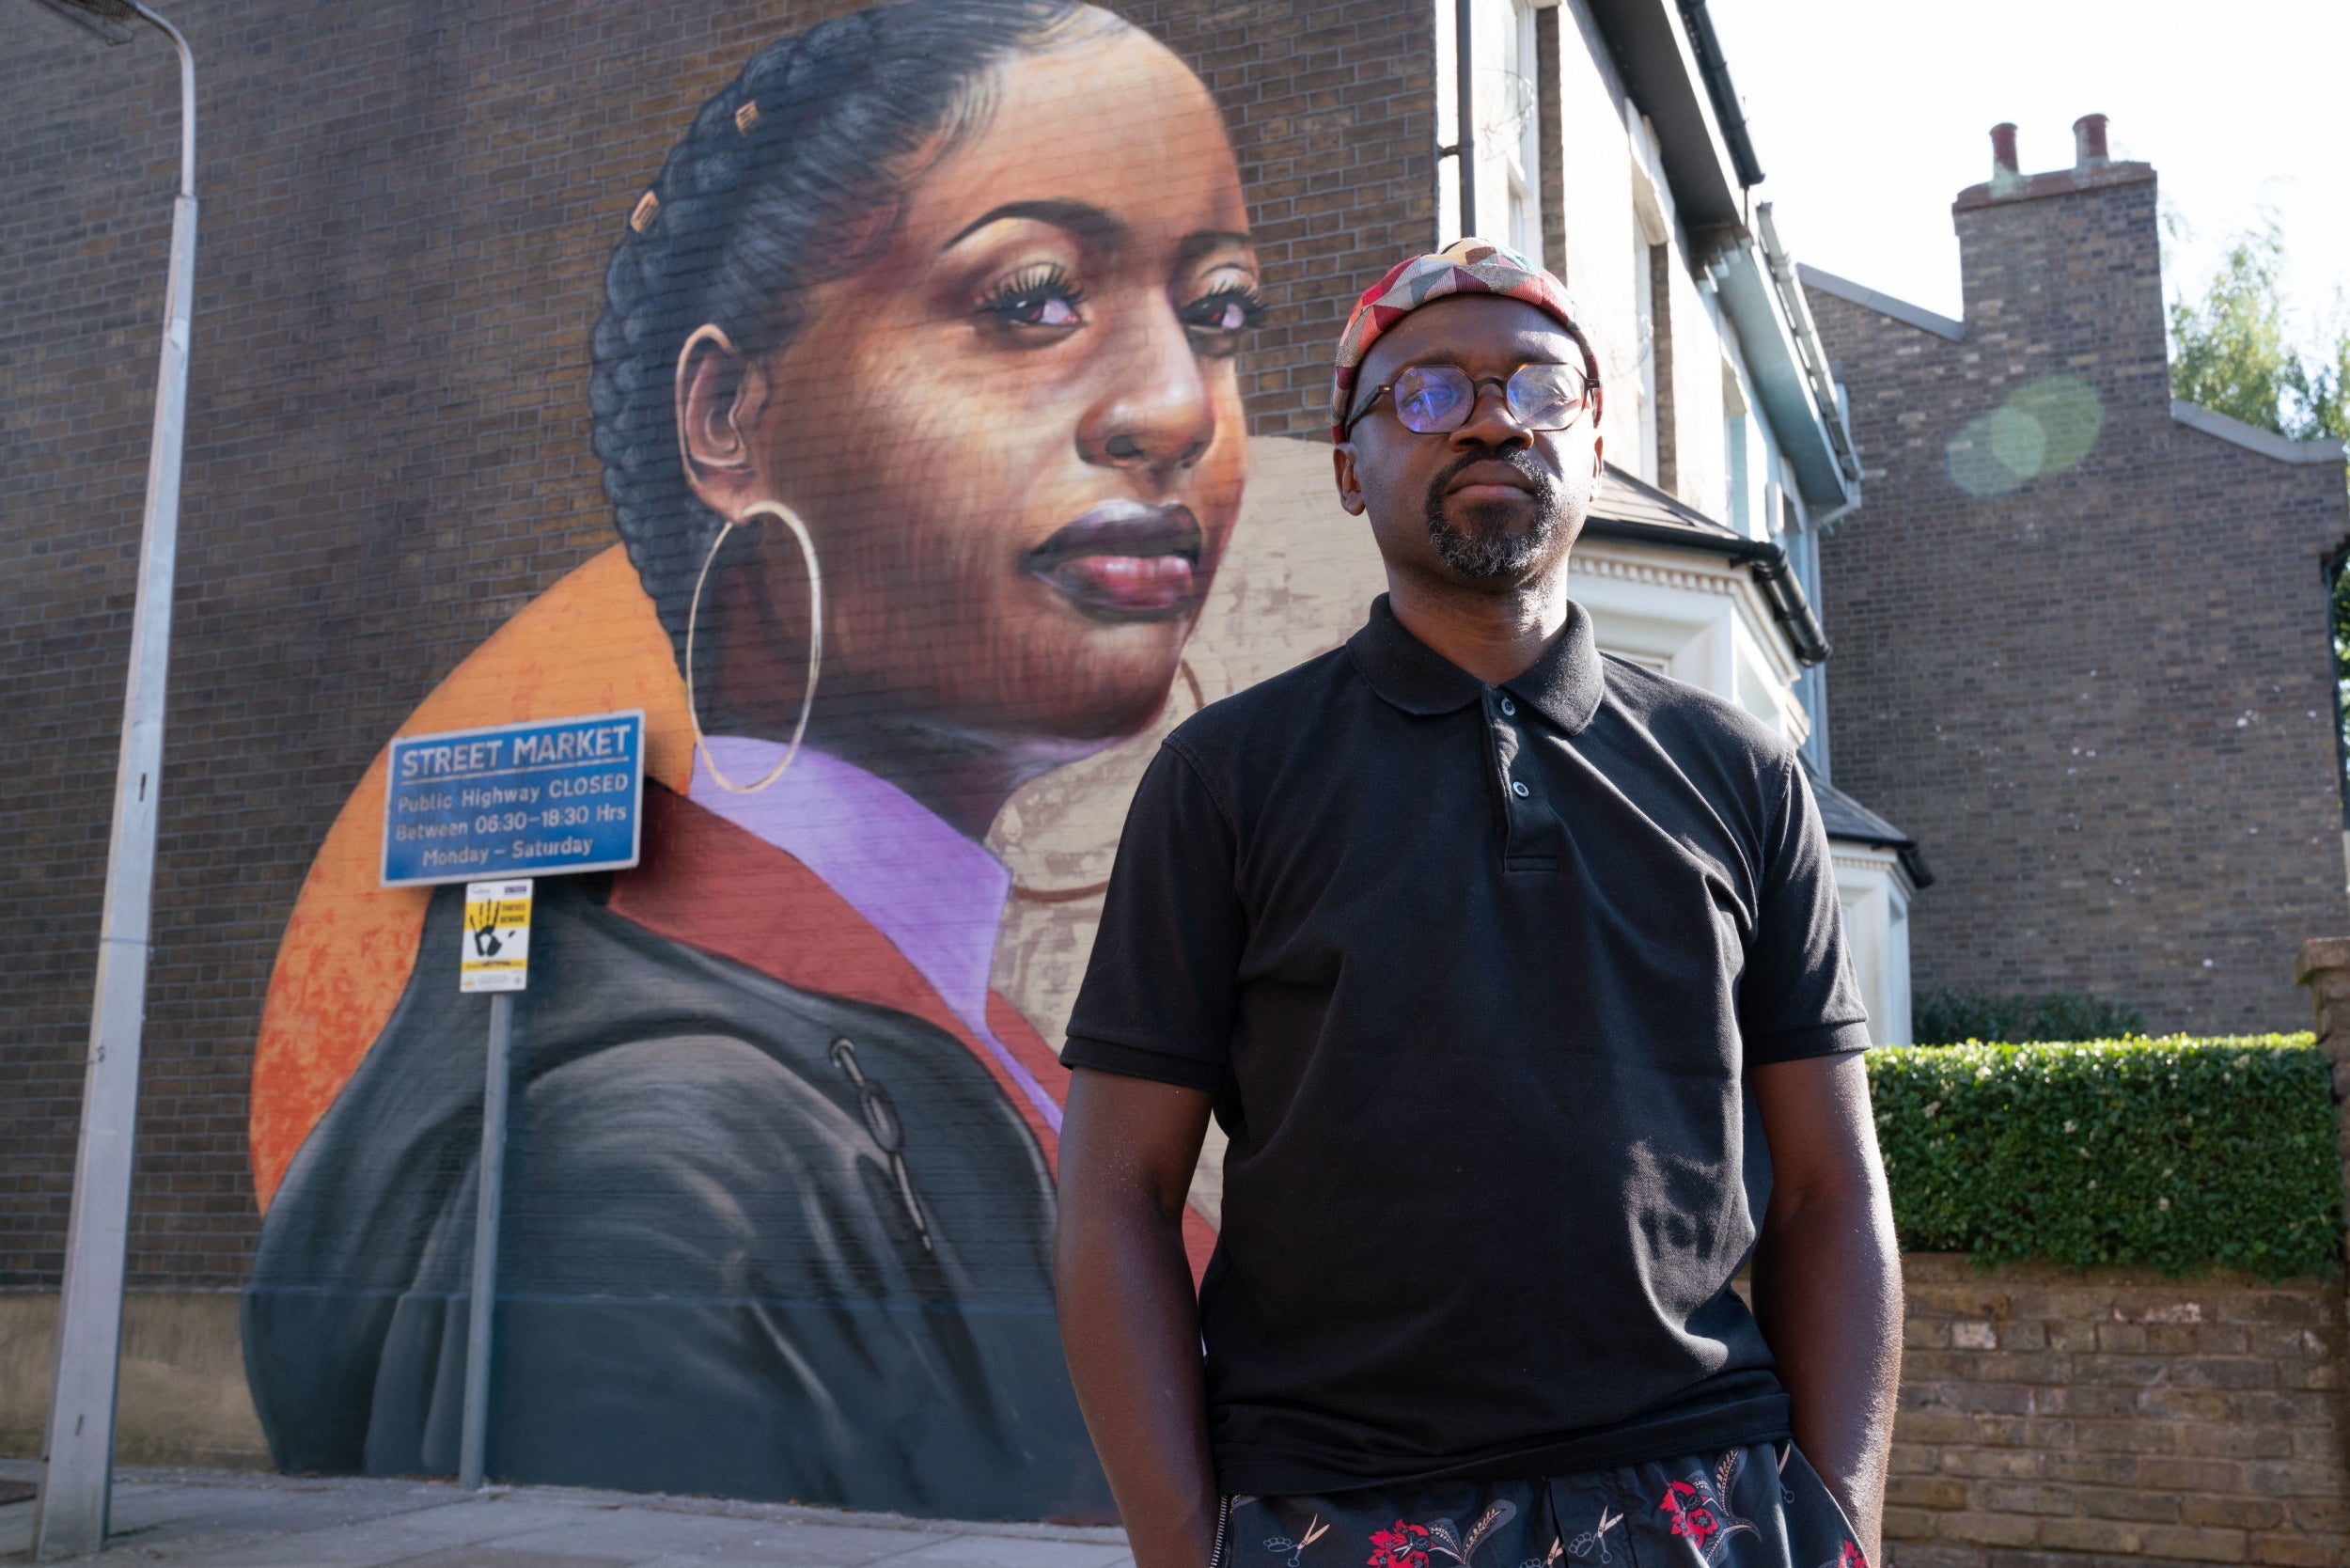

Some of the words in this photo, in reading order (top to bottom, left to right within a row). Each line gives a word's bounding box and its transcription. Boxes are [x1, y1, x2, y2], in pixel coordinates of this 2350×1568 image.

[401, 741, 503, 776] STREET
[513, 726, 631, 764] MARKET
[399, 793, 452, 812] Public
[462, 786, 540, 808] Highway
[549, 774, 629, 798] CLOSED
[396, 821, 468, 841] Between
[596, 803, 627, 822] Hrs
[423, 847, 489, 867] Monday
[512, 836, 593, 859] Saturday
